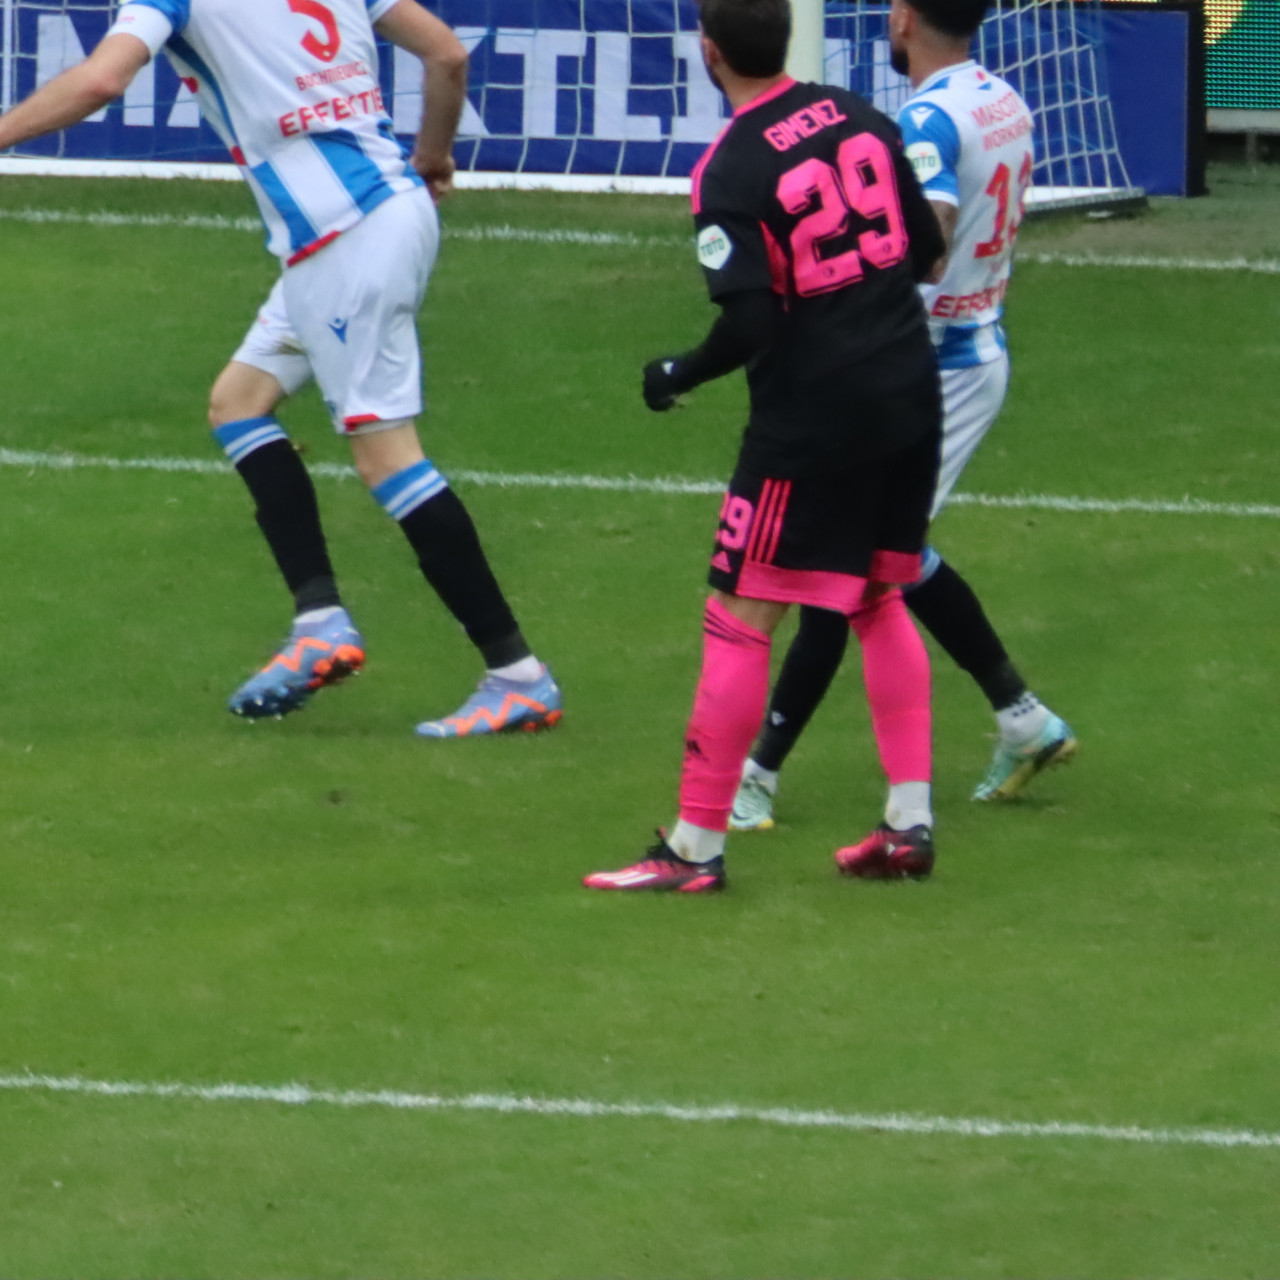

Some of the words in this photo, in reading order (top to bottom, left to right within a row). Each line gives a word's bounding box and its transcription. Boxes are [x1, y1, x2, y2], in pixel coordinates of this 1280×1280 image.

[913, 155, 936, 169] OTO
[775, 131, 909, 298] 29
[699, 238, 726, 257] TOTO
